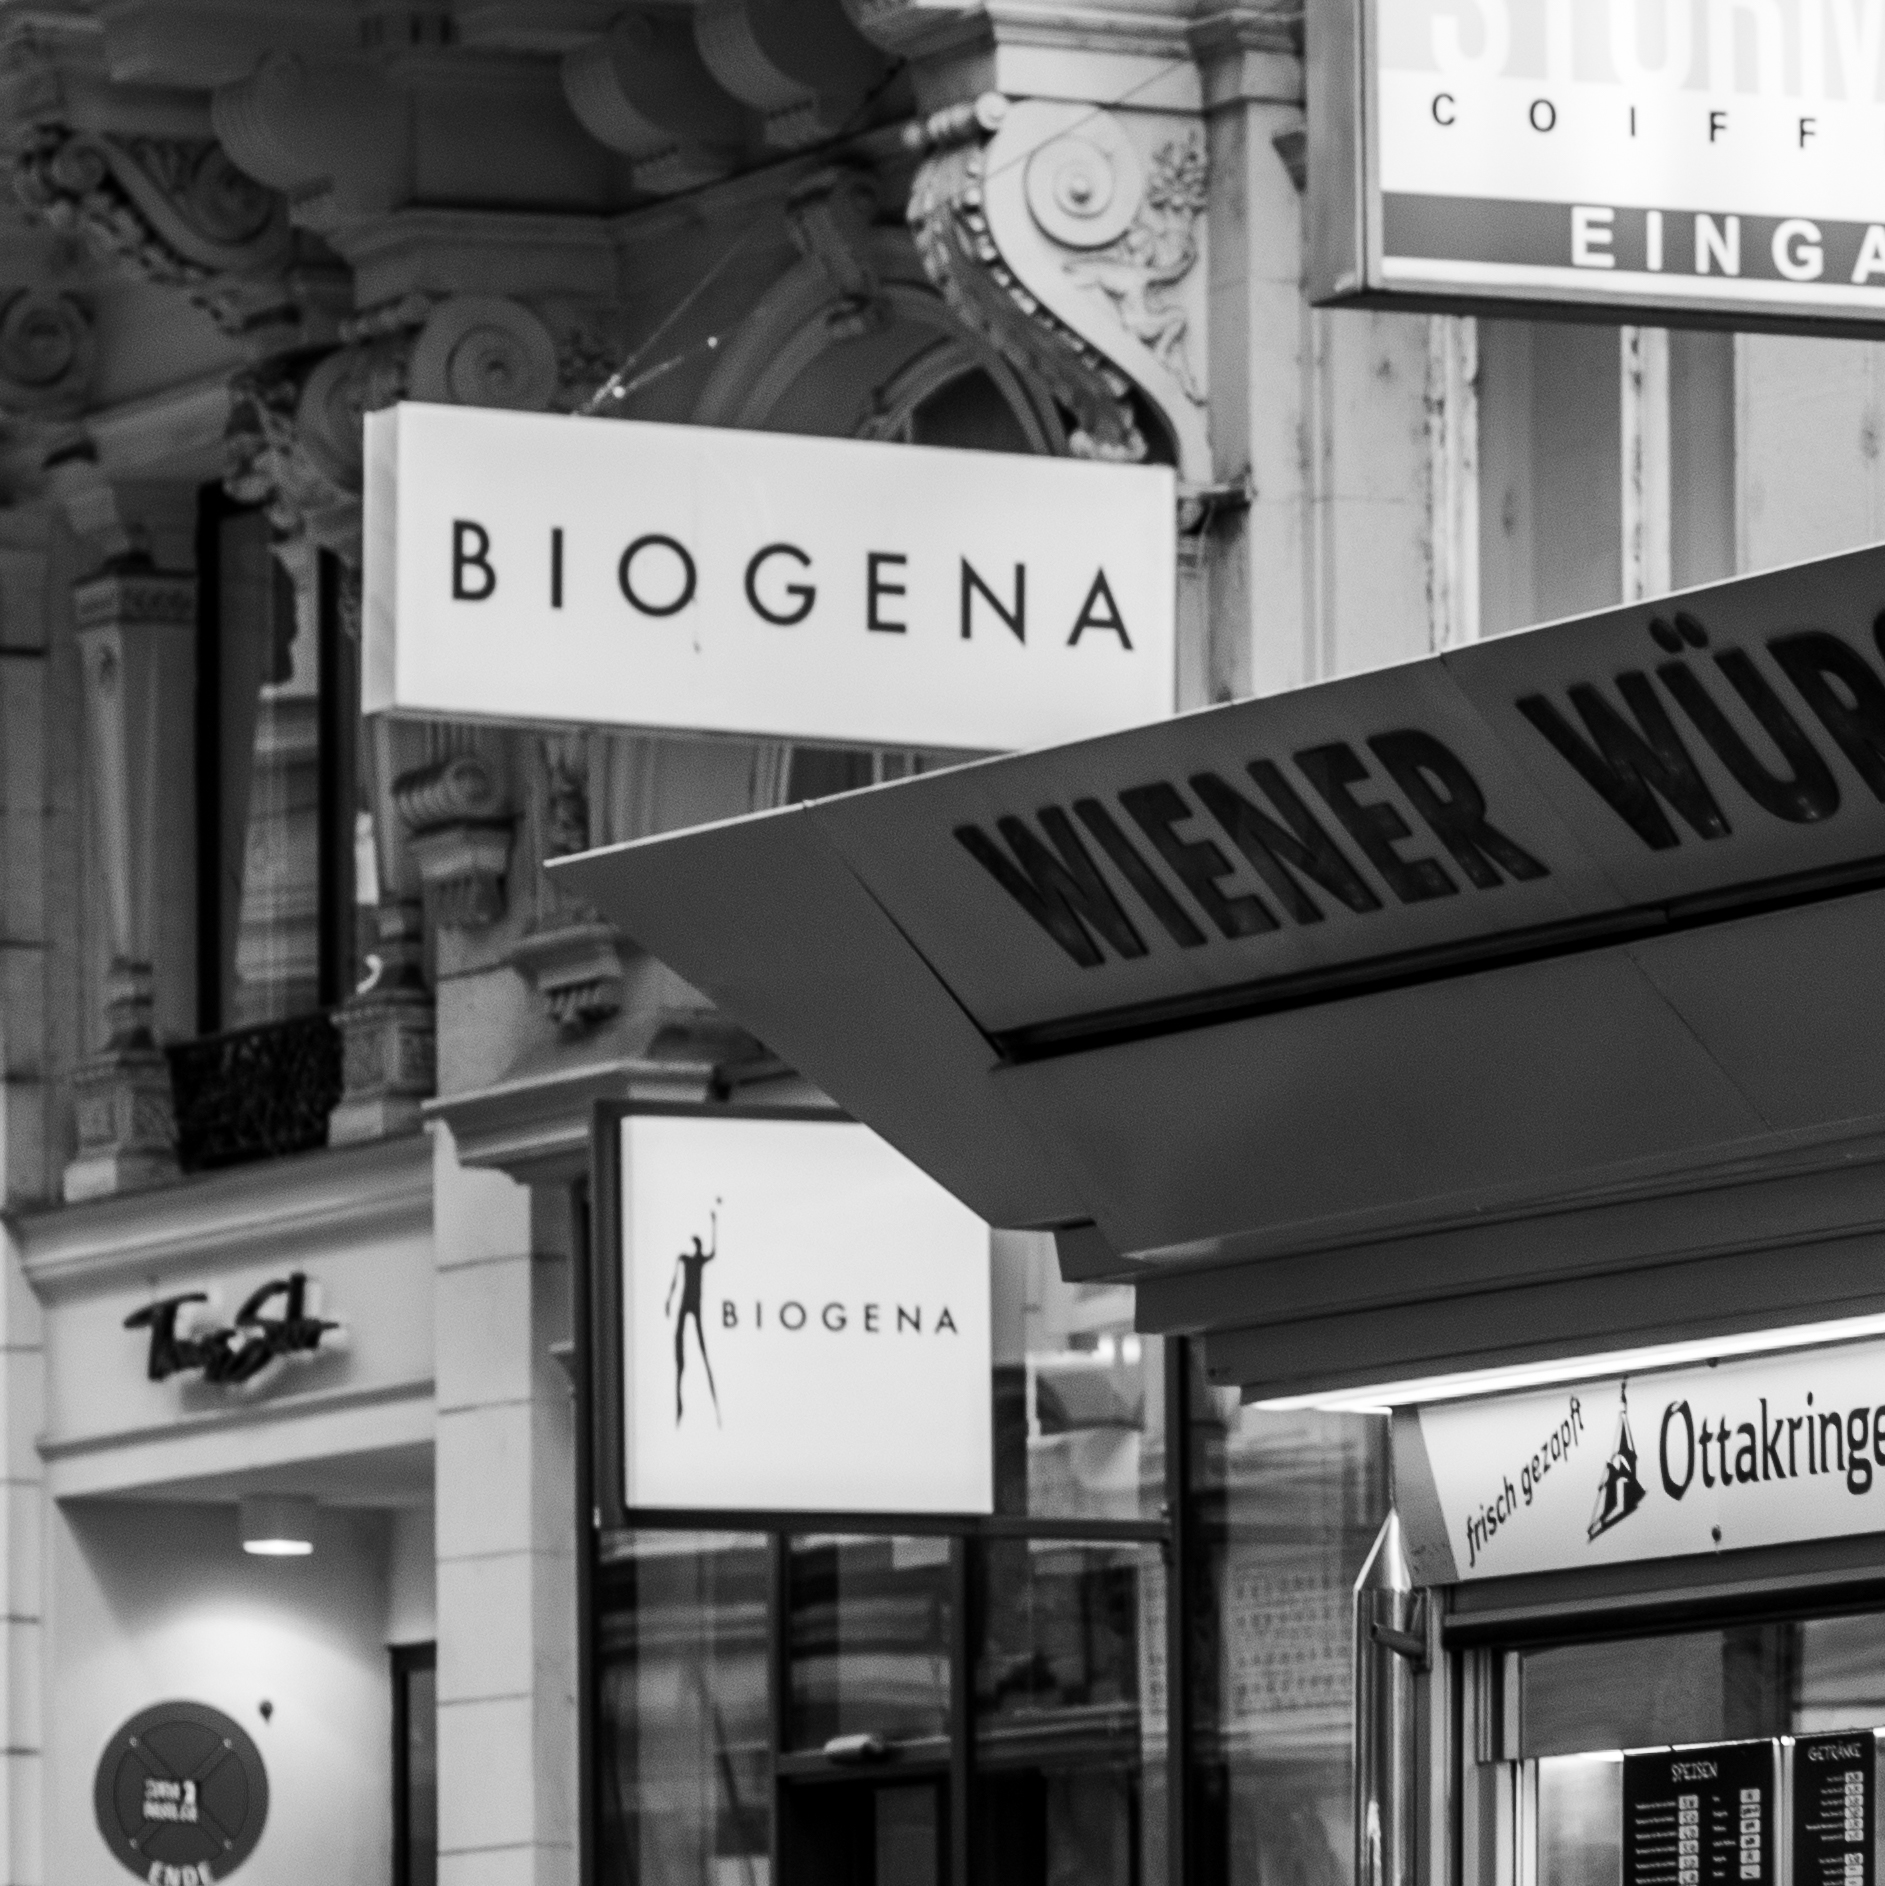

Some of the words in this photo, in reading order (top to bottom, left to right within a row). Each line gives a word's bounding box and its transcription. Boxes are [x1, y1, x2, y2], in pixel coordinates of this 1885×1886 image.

[450, 518, 1136, 653] BIOGENA
[952, 727, 1553, 970] WIENER
[720, 1299, 960, 1337] BIOGENA
[1464, 1475, 1517, 1567] frisch
[1520, 1395, 1586, 1507] gezapft
